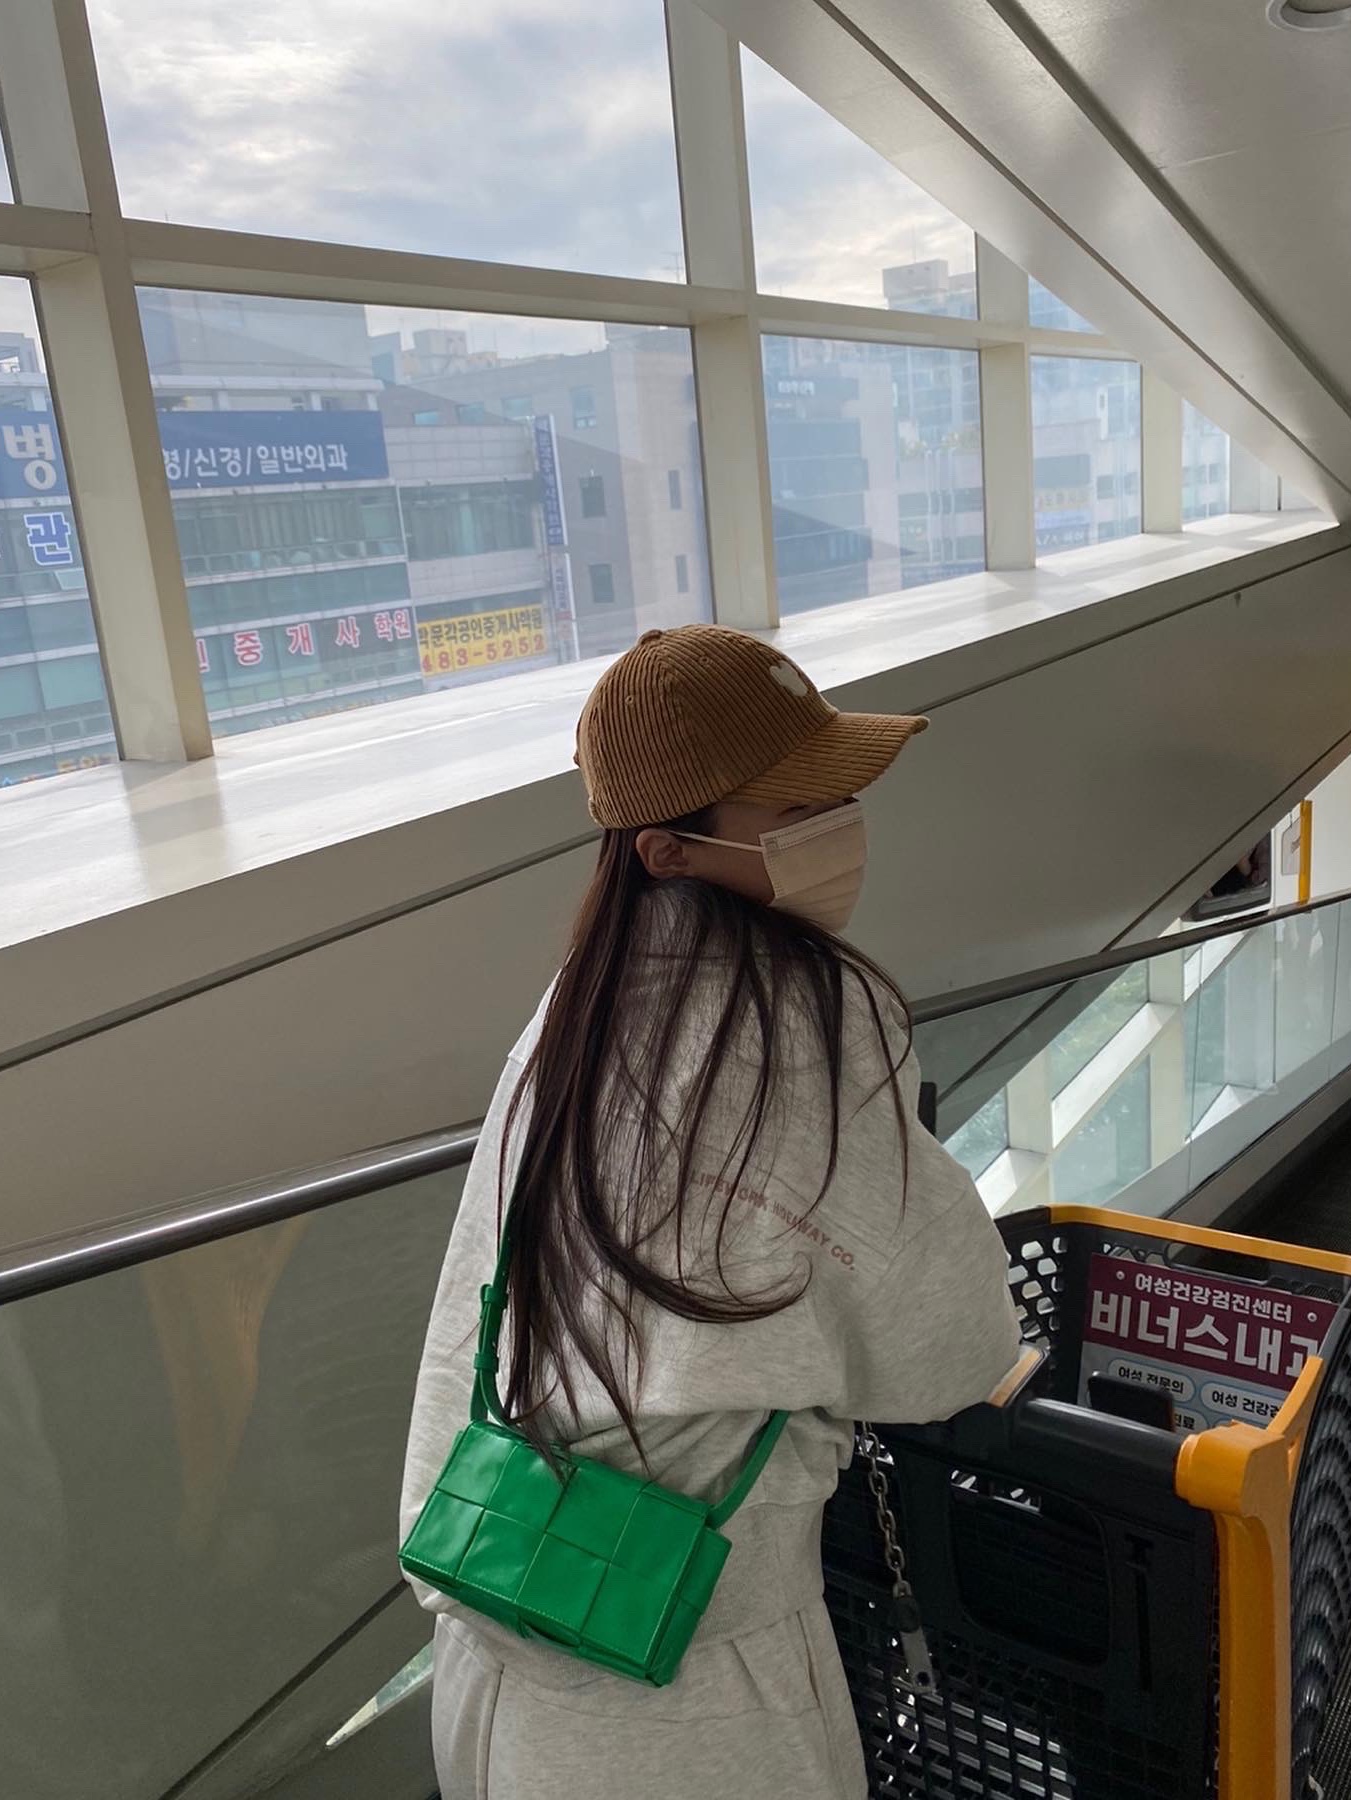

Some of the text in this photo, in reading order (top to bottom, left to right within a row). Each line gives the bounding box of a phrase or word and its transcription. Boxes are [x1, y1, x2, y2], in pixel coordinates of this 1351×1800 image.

[2, 423, 58, 491] 병
[23, 511, 74, 567] 관
[831, 1244, 855, 1271] CO.
[1134, 1272, 1293, 1324] 여성건강검진센터
[1211, 1390, 1238, 1409] 여성
